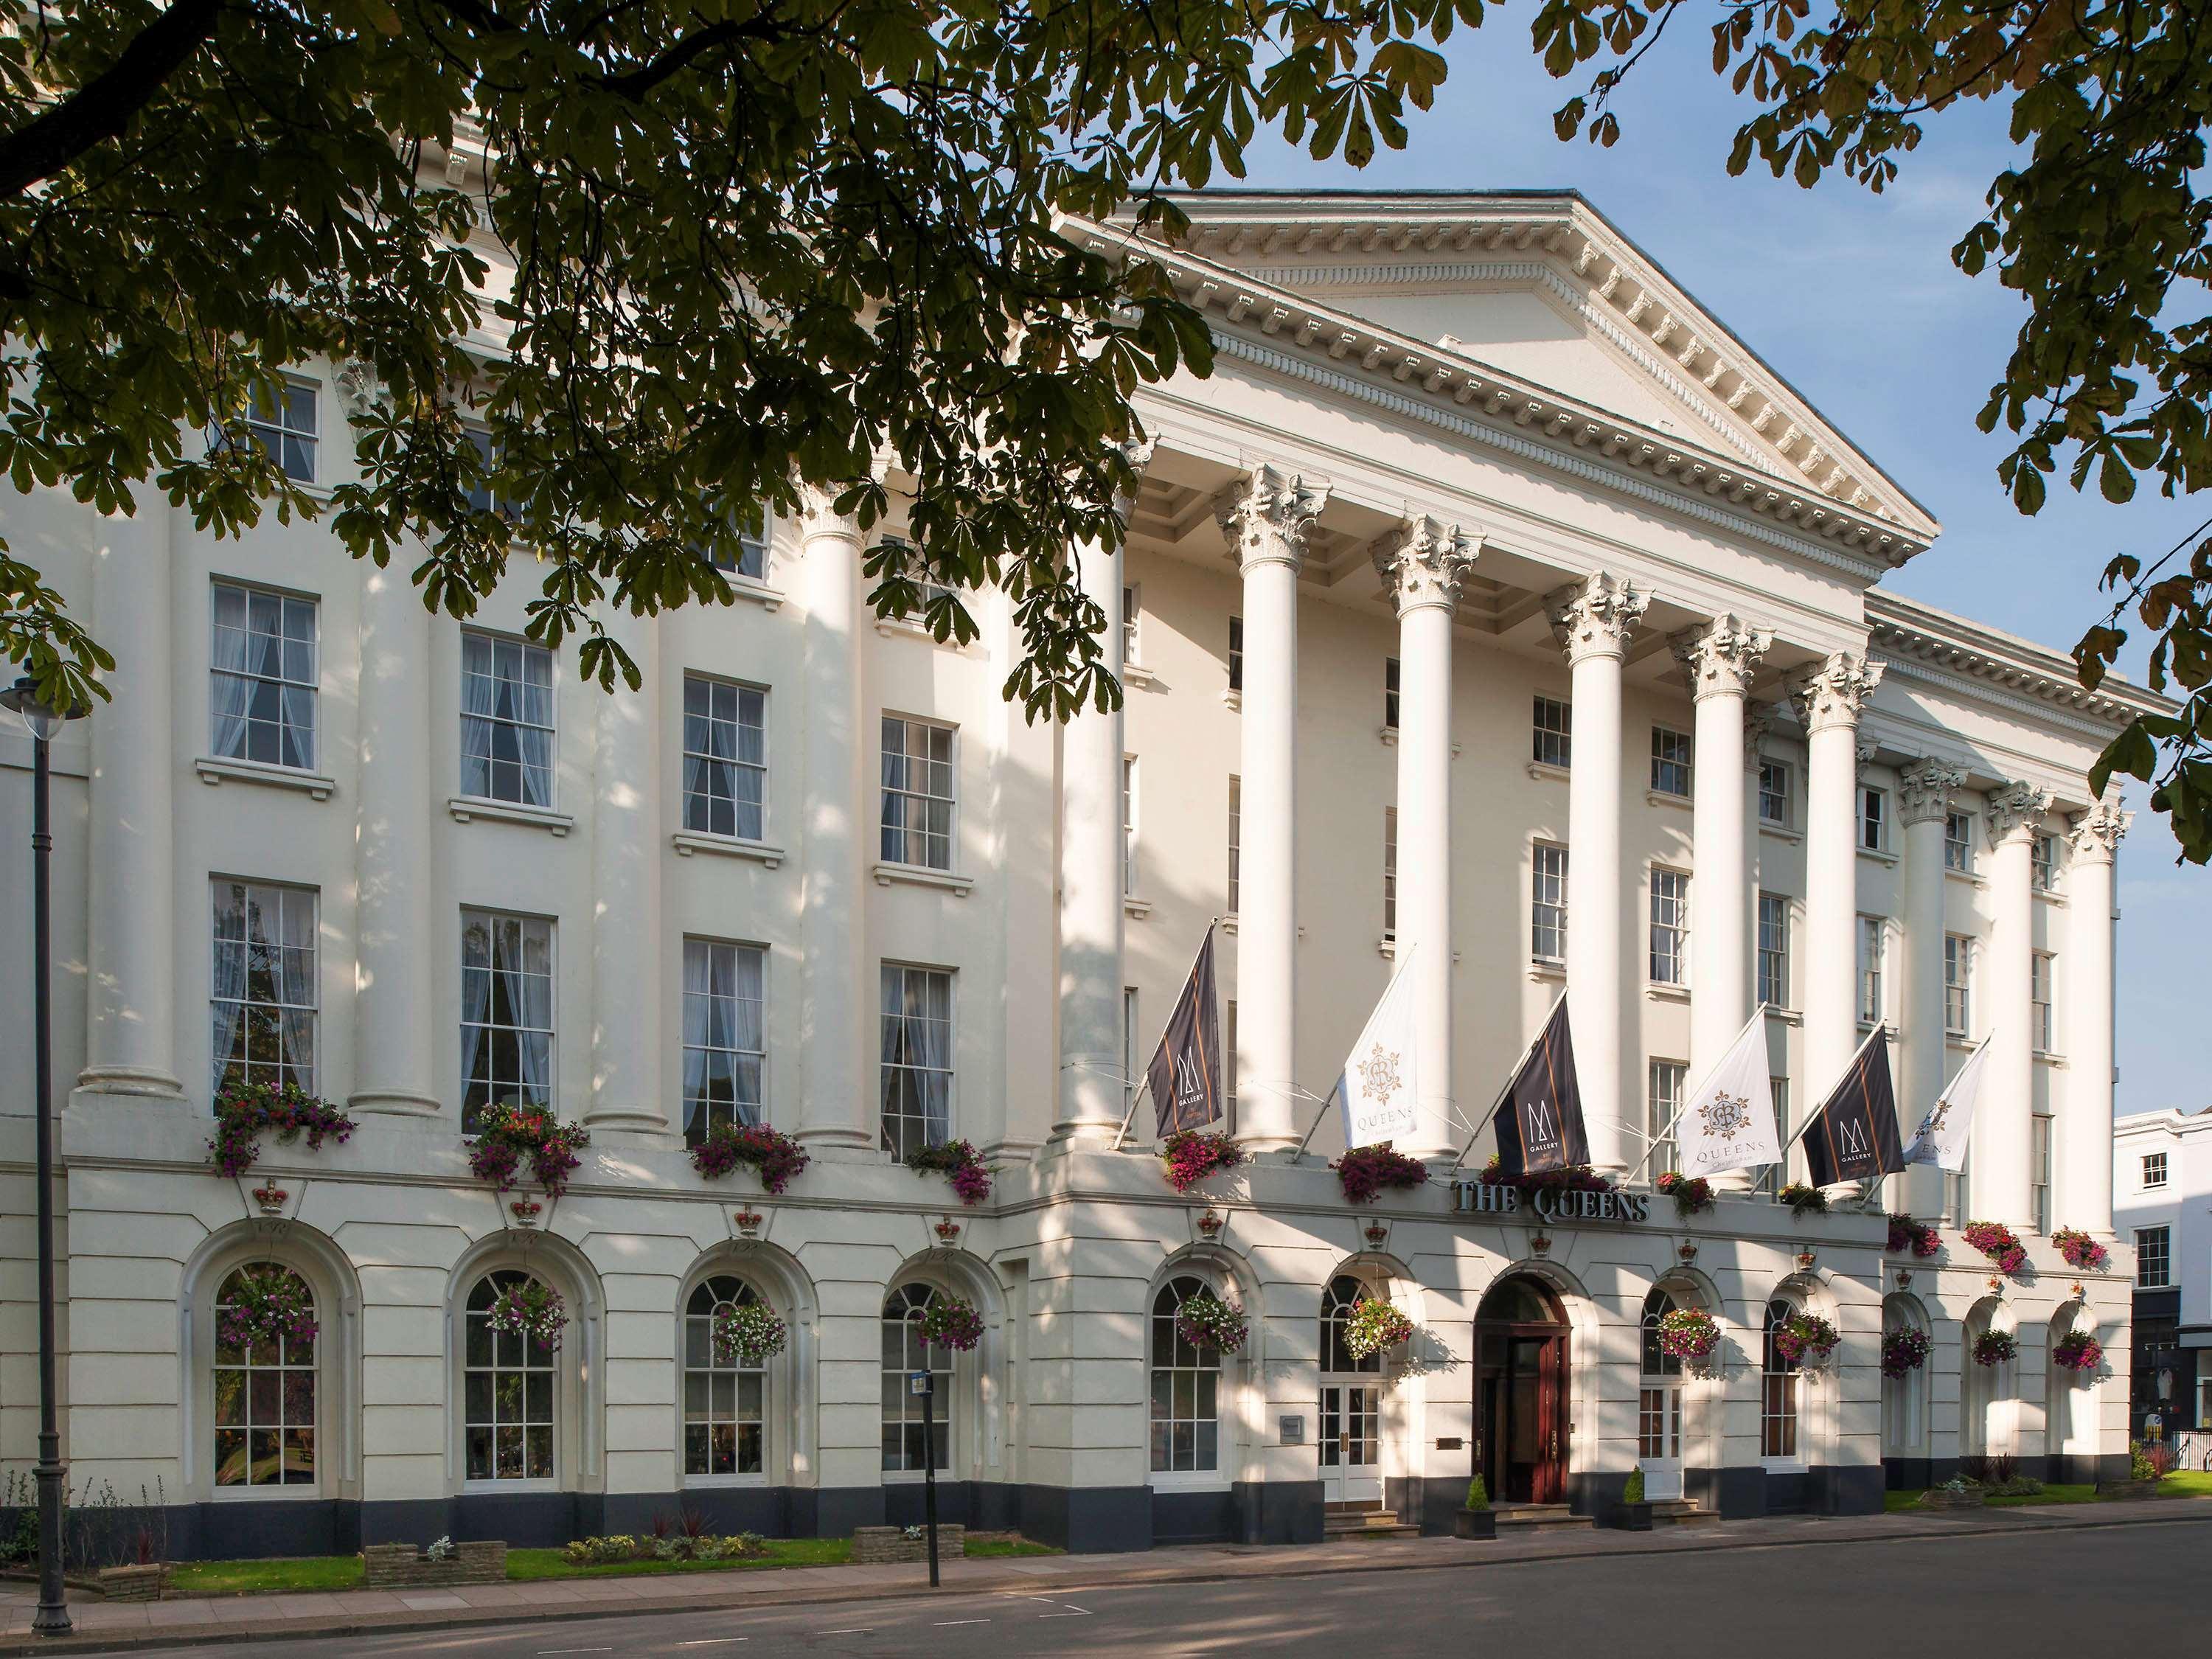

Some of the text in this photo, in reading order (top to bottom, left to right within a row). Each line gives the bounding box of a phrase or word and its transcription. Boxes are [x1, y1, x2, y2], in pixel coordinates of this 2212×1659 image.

[1178, 1093, 1204, 1107] GALLERY
[1357, 1106, 1412, 1130] QUEENS
[1530, 1142, 1559, 1152] GALLERY
[1697, 1141, 1764, 1163] QUEENS
[1841, 1152, 1871, 1163] GALLERY
[1455, 1180, 1651, 1224] THE QUEENS
